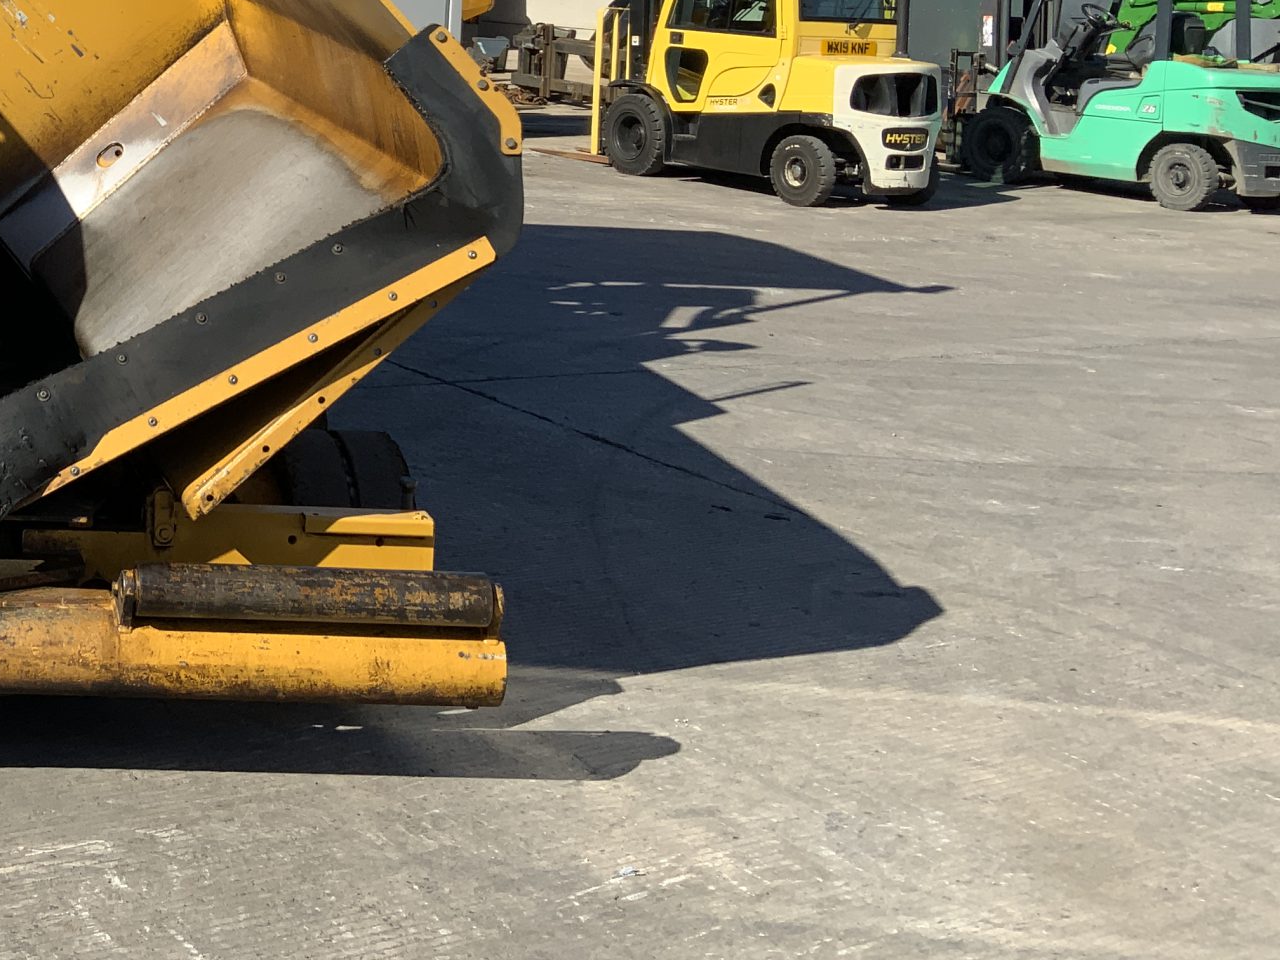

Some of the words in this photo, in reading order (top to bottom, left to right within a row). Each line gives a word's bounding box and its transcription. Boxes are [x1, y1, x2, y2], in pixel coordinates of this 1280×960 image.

[851, 42, 870, 55] KNF
[710, 98, 738, 106] HYSTER
[885, 133, 927, 144] HYSTER
